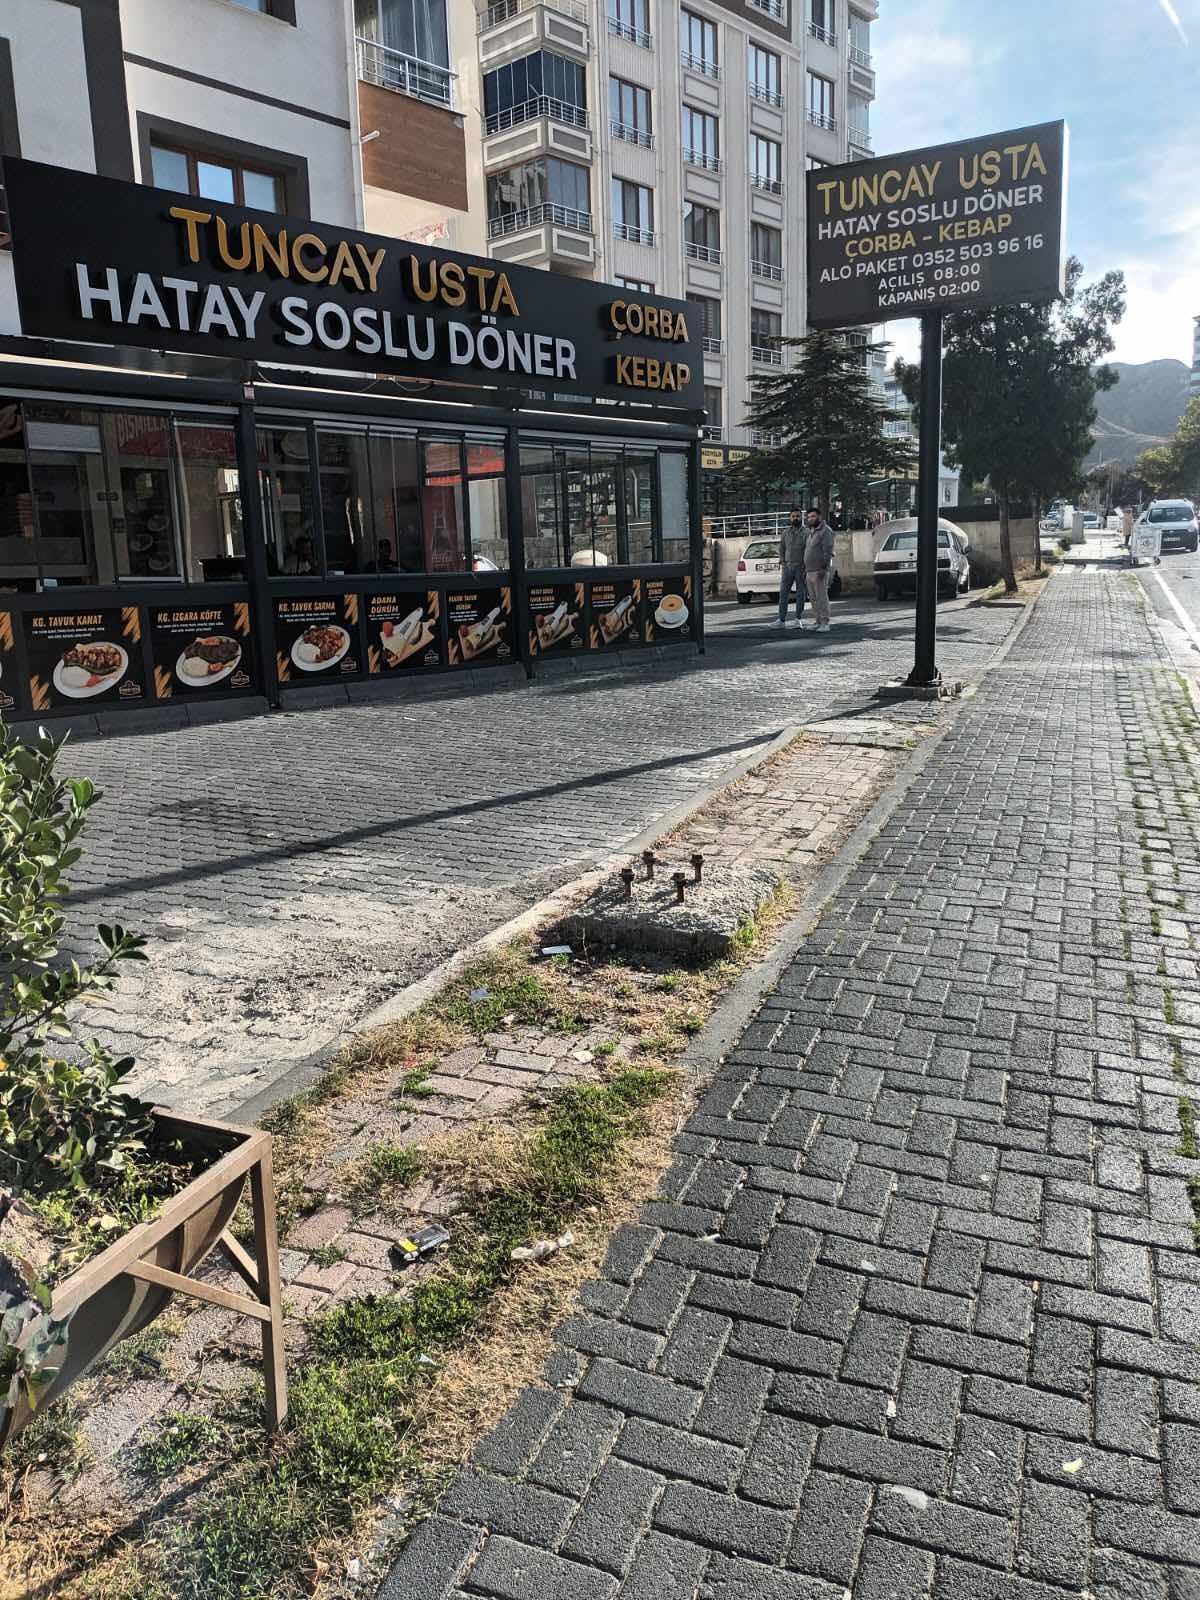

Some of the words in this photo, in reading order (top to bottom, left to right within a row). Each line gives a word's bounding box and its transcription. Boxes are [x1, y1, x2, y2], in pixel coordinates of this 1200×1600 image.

[816, 161, 942, 215] TUNCAY
[959, 141, 1047, 190] USTA
[818, 212, 882, 240] HATAY
[887, 203, 957, 229] SOSLU
[964, 185, 1043, 213] DÖNER
[820, 265, 852, 283] ALO
[855, 256, 908, 277] PAKET
[912, 248, 955, 268] 0352
[959, 242, 993, 260] 503
[998, 237, 1020, 255] 96
[1023, 233, 1044, 250] 16
[845, 230, 916, 263] ÇORBA
[938, 213, 1012, 243] KEBAP
[168, 206, 387, 293] TUNCAY
[409, 254, 520, 318] USTA
[877, 271, 925, 291] AÇILIŞ
[934, 262, 981, 282] 08:00
[877, 286, 936, 308] KAPANIŞ
[939, 280, 981, 298] 02:00
[74, 263, 266, 340] HATAY
[279, 296, 436, 362] SOSLU
[448, 314, 577, 381] DÖNER
[609, 299, 690, 344] ÇORBA
[615, 353, 691, 393] KEBAP
[32, 617, 46, 628] KG.
[48, 616, 75, 627] TAVUK
[76, 615, 103, 626] KANAT
[157, 612, 170, 623] KG.
[291, 602, 313, 612] TAVUK
[371, 596, 397, 605] ADANA
